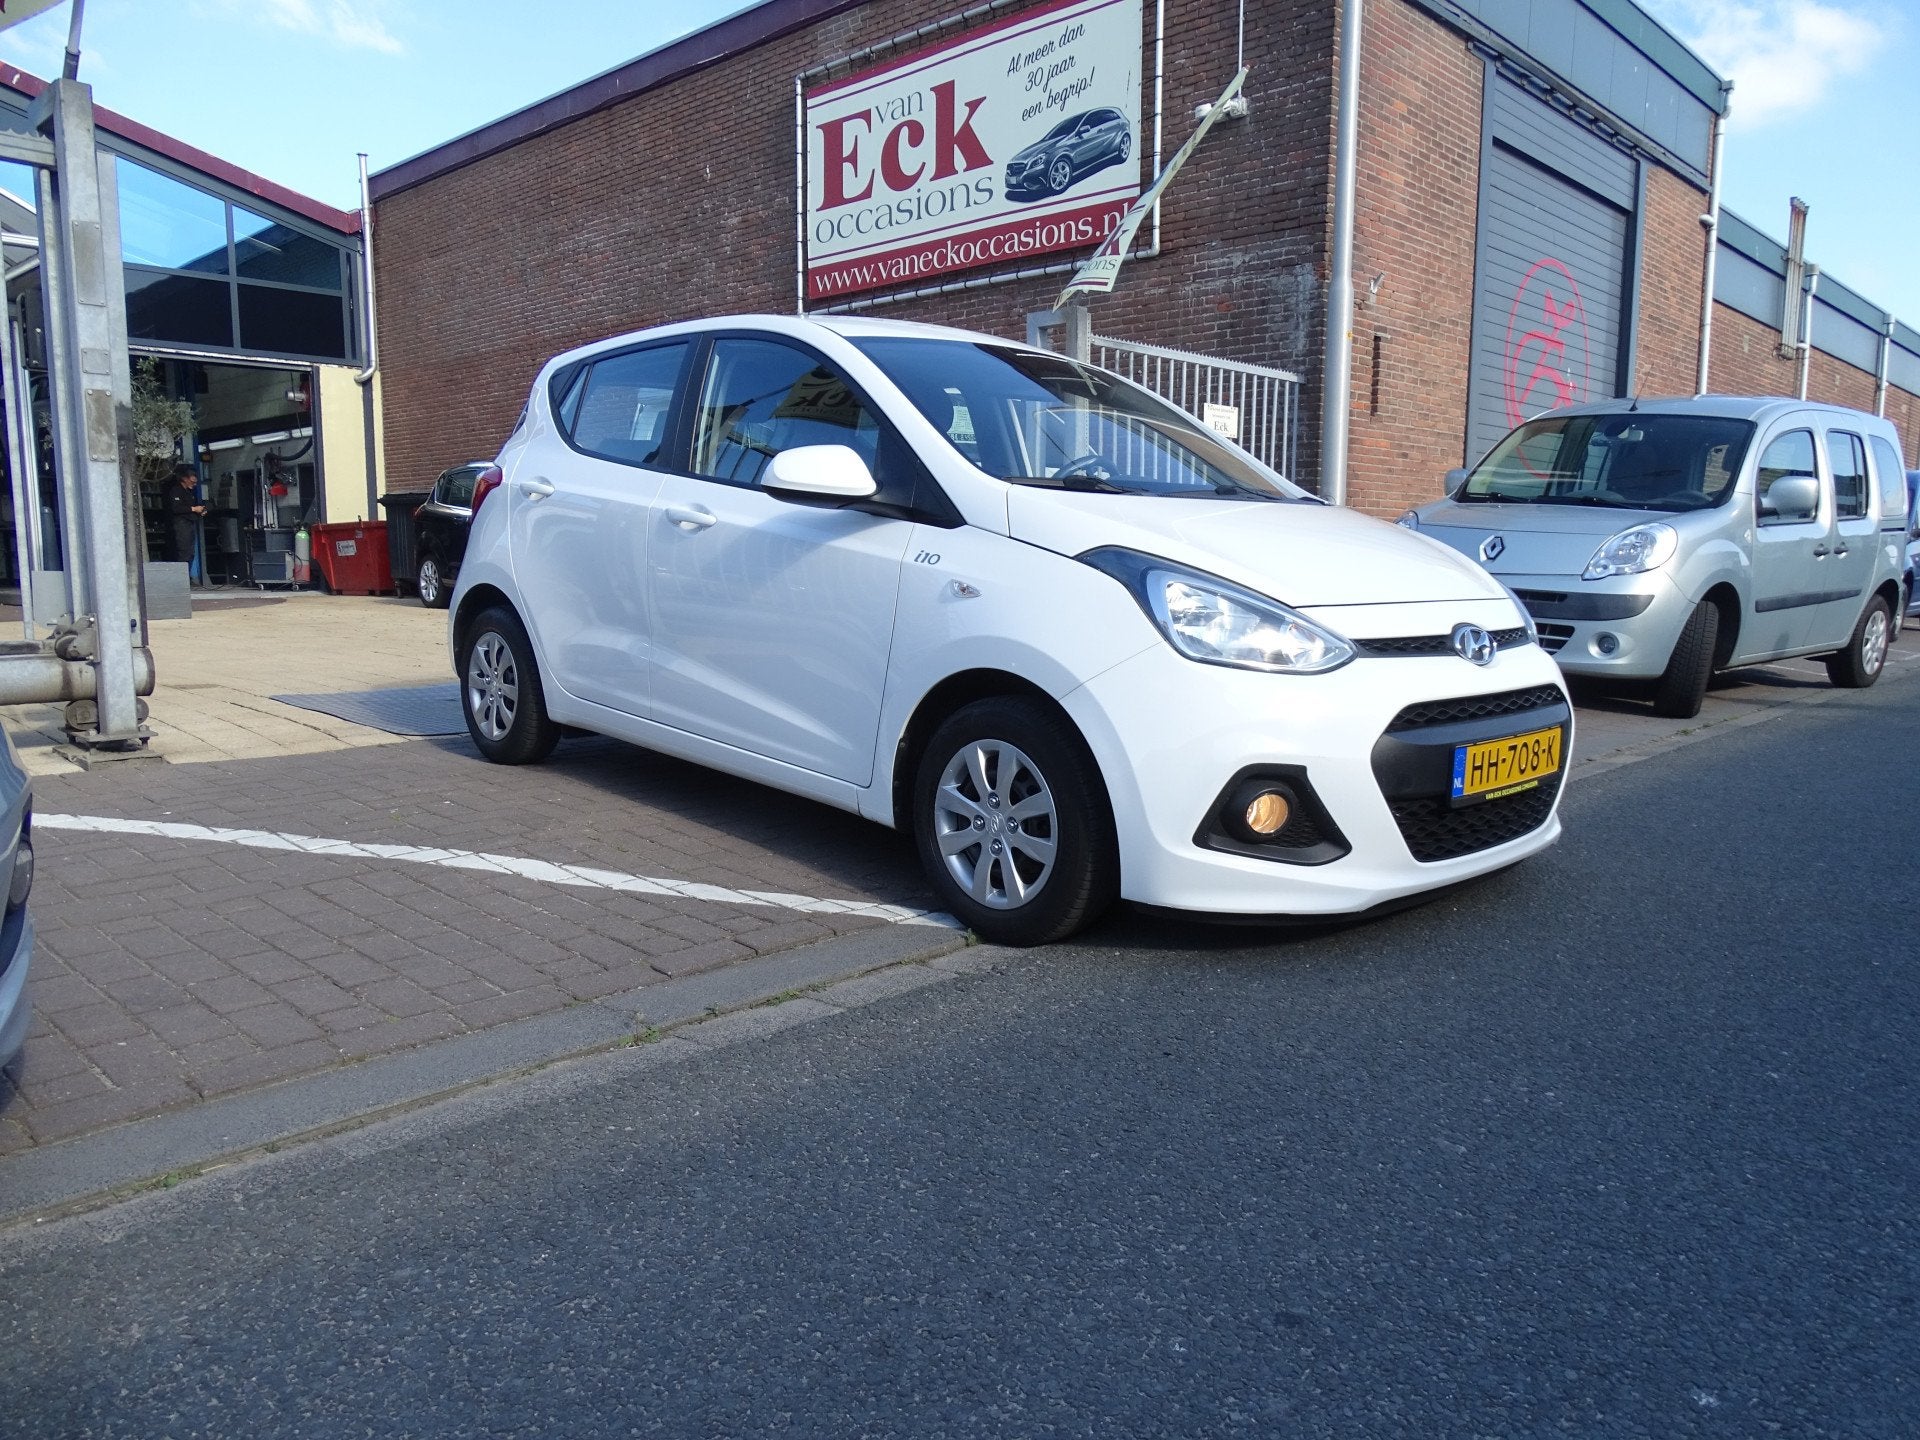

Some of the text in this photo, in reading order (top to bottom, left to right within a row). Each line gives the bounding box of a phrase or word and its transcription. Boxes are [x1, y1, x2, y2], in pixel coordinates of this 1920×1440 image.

[1007, 24, 1085, 77] Al meer dan
[1022, 65, 1095, 121] een begrip!
[1025, 55, 1076, 93] 30 jaar
[875, 91, 924, 124] van
[816, 79, 994, 212] Eck
[815, 176, 994, 244] occasions
[1214, 420, 1229, 432] Eck
[913, 549, 941, 565] i10
[1453, 776, 1464, 789] NL
[1470, 734, 1556, 787] HH-708-K
